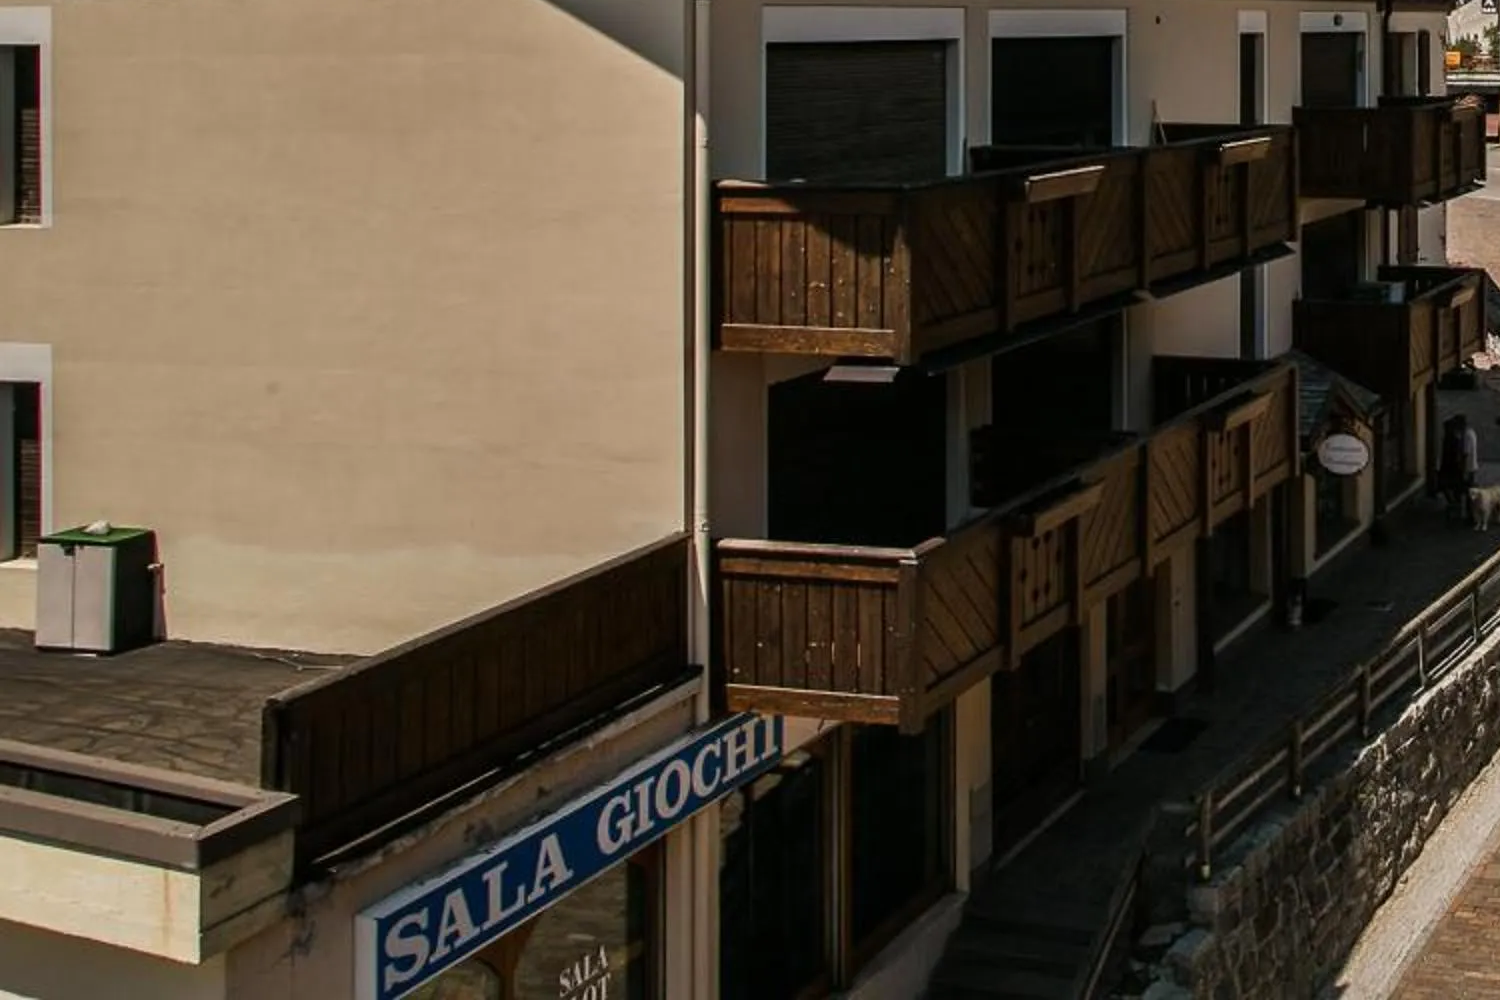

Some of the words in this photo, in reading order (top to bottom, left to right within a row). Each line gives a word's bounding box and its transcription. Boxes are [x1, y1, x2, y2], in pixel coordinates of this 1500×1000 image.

[385, 833, 572, 990] SALA
[598, 714, 783, 856] GIOCHI
[559, 944, 609, 998] SALA
